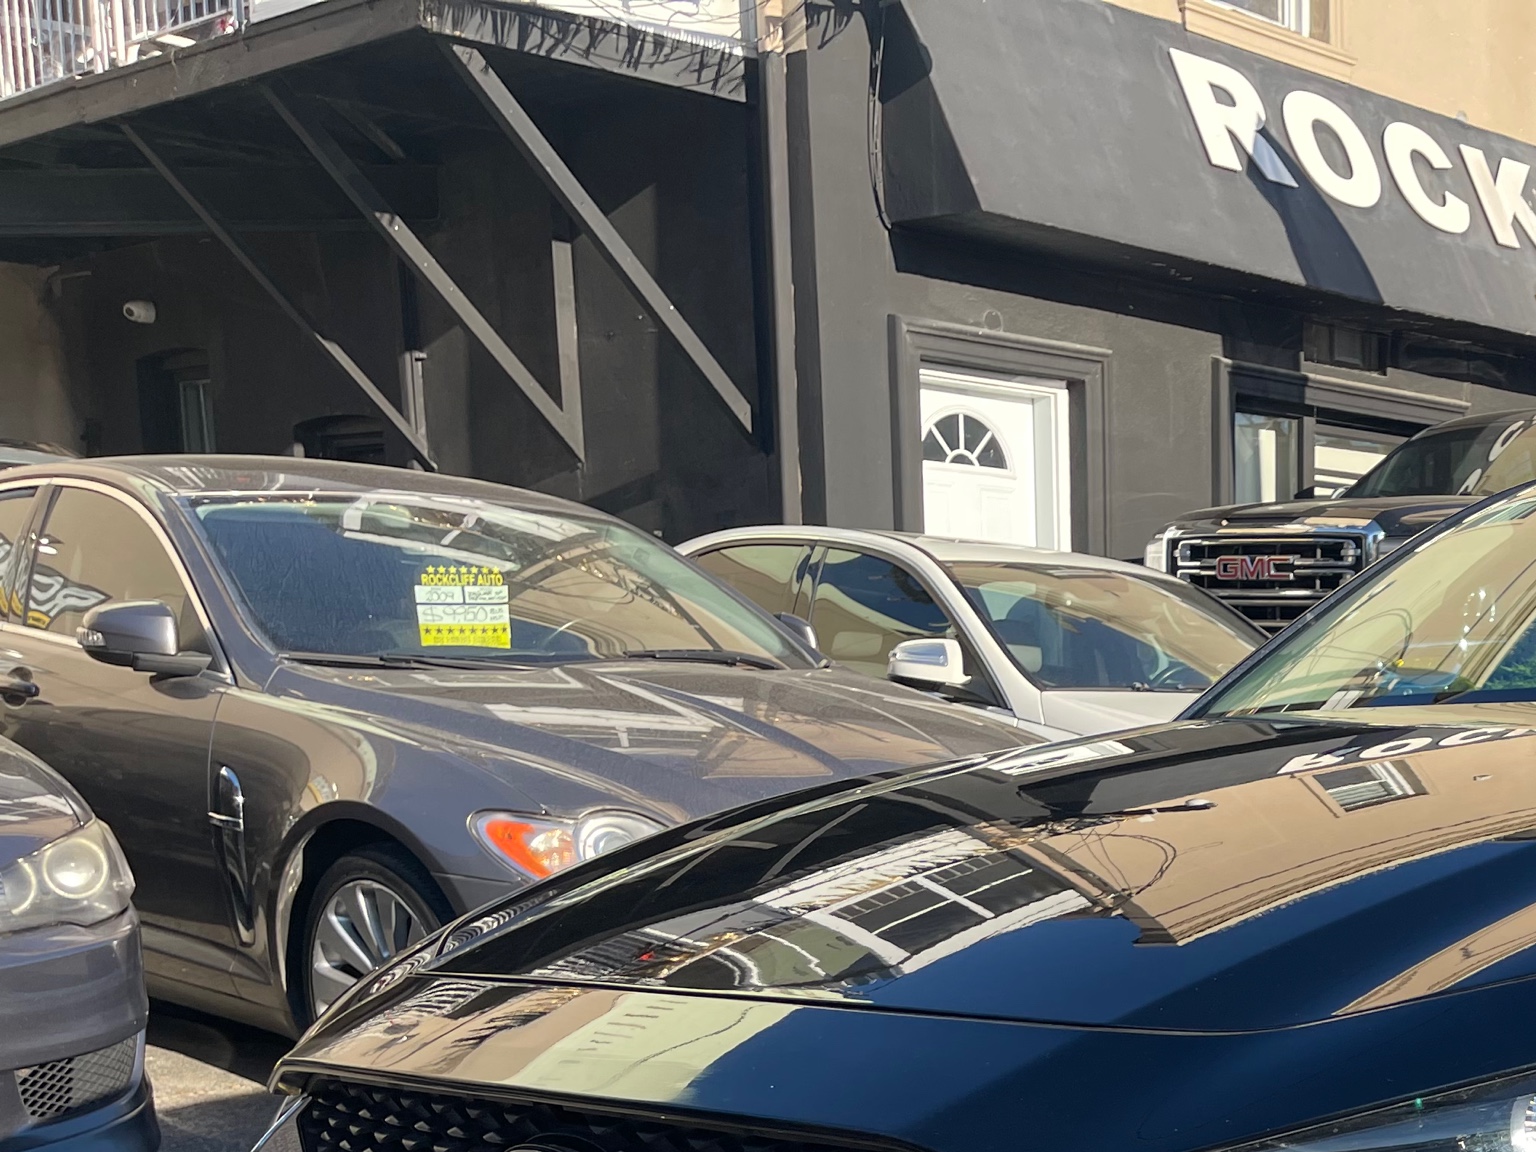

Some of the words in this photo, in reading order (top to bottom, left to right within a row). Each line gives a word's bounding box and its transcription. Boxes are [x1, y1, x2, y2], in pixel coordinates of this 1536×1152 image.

[1215, 555, 1295, 581] GMC
[420, 573, 476, 586] ROCKCLIFF
[477, 573, 504, 586] AUTO
